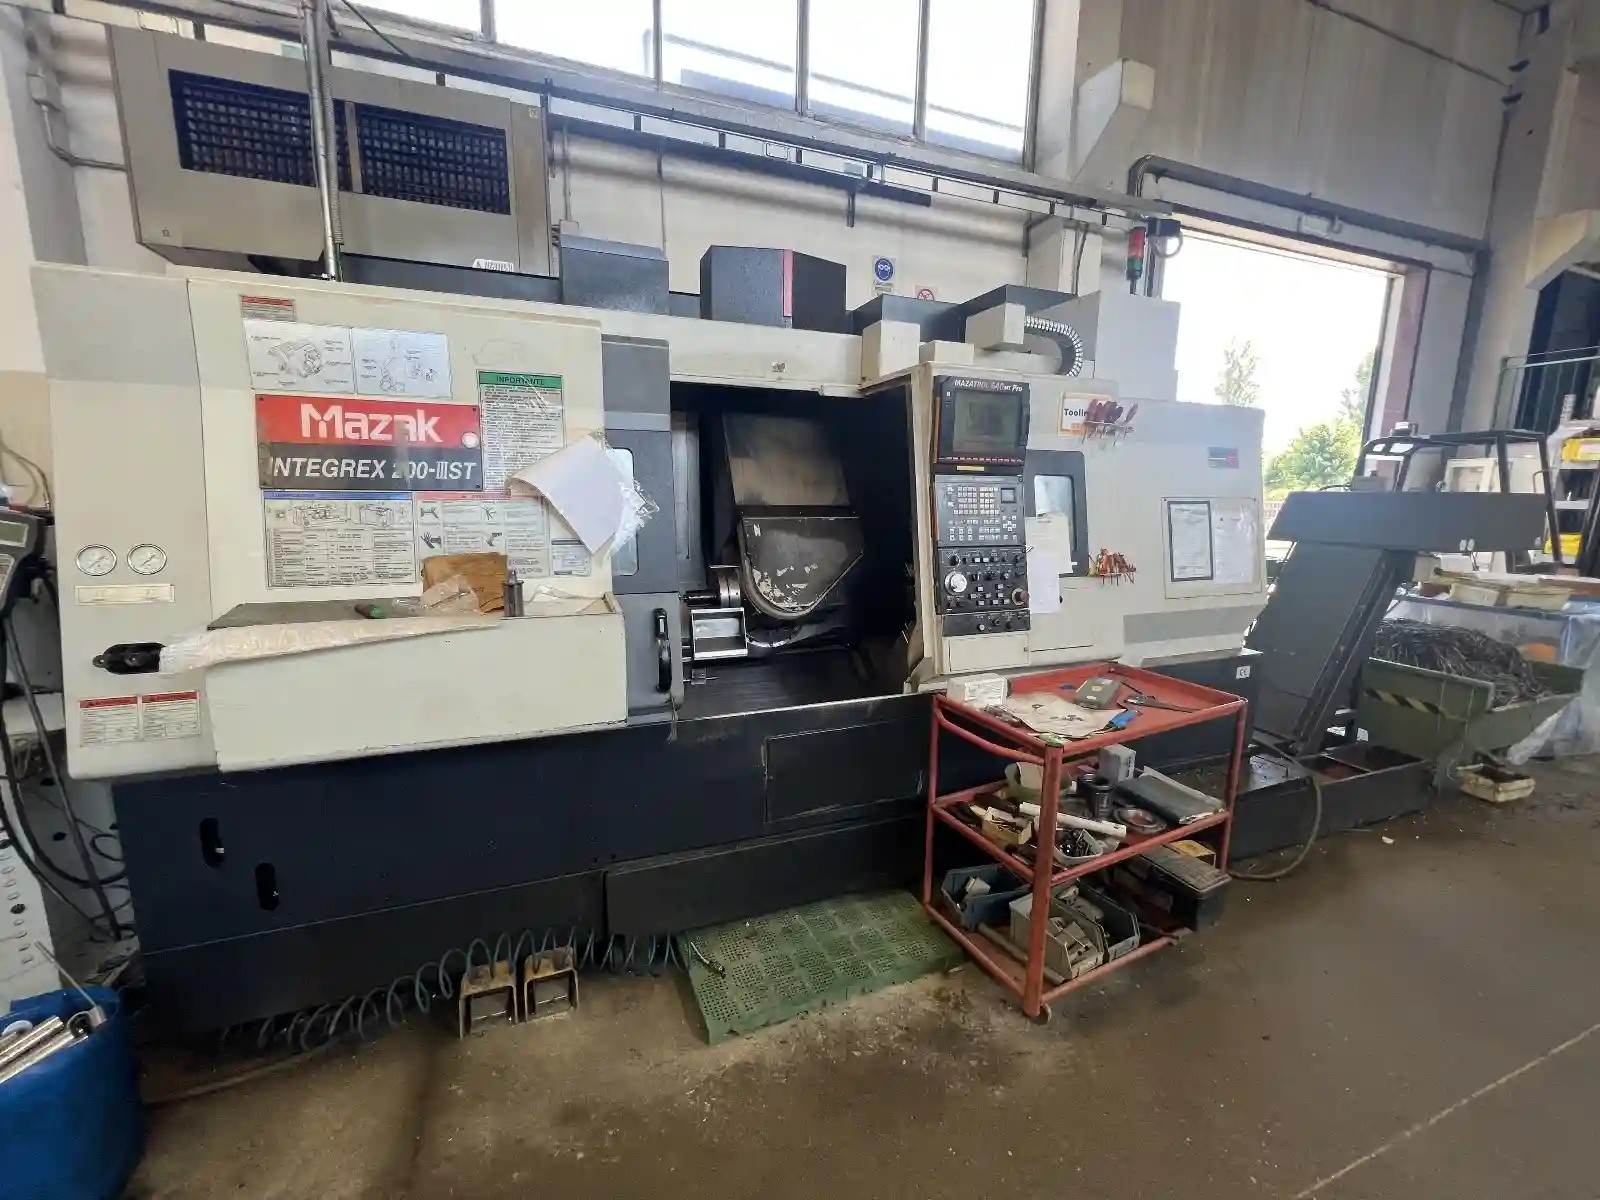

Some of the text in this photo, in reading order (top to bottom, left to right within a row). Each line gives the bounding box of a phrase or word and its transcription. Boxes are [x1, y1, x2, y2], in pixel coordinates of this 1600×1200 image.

[1012, 384, 1023, 392] Pro
[301, 403, 444, 443] Mazak
[269, 457, 387, 479] INTEGREX
